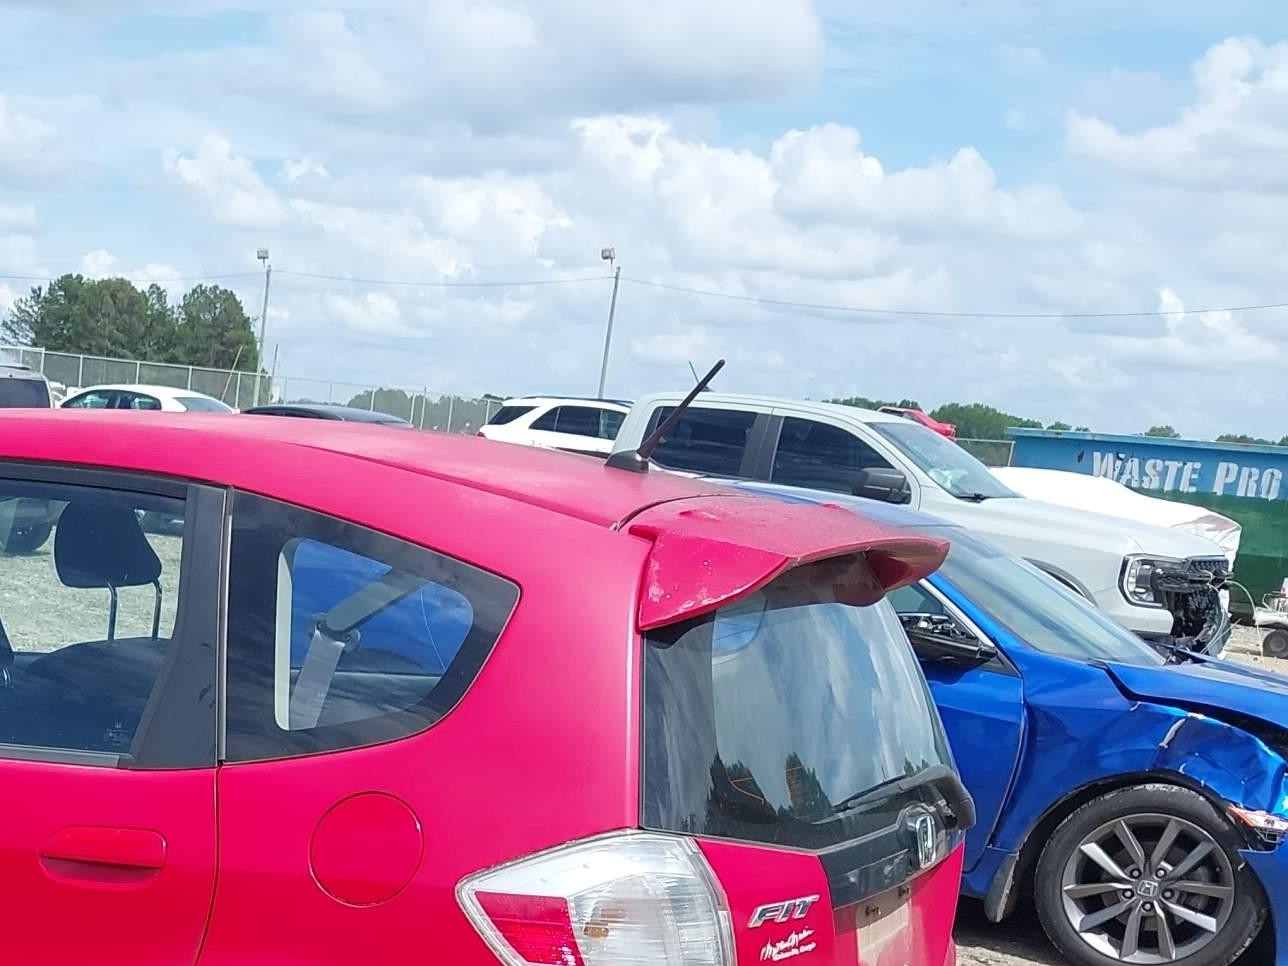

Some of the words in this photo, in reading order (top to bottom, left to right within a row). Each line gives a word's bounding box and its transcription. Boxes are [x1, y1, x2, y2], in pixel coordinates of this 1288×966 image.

[1092, 451, 1202, 494] WASTE
[1213, 461, 1283, 501] PRO
[747, 894, 820, 928] FIT
